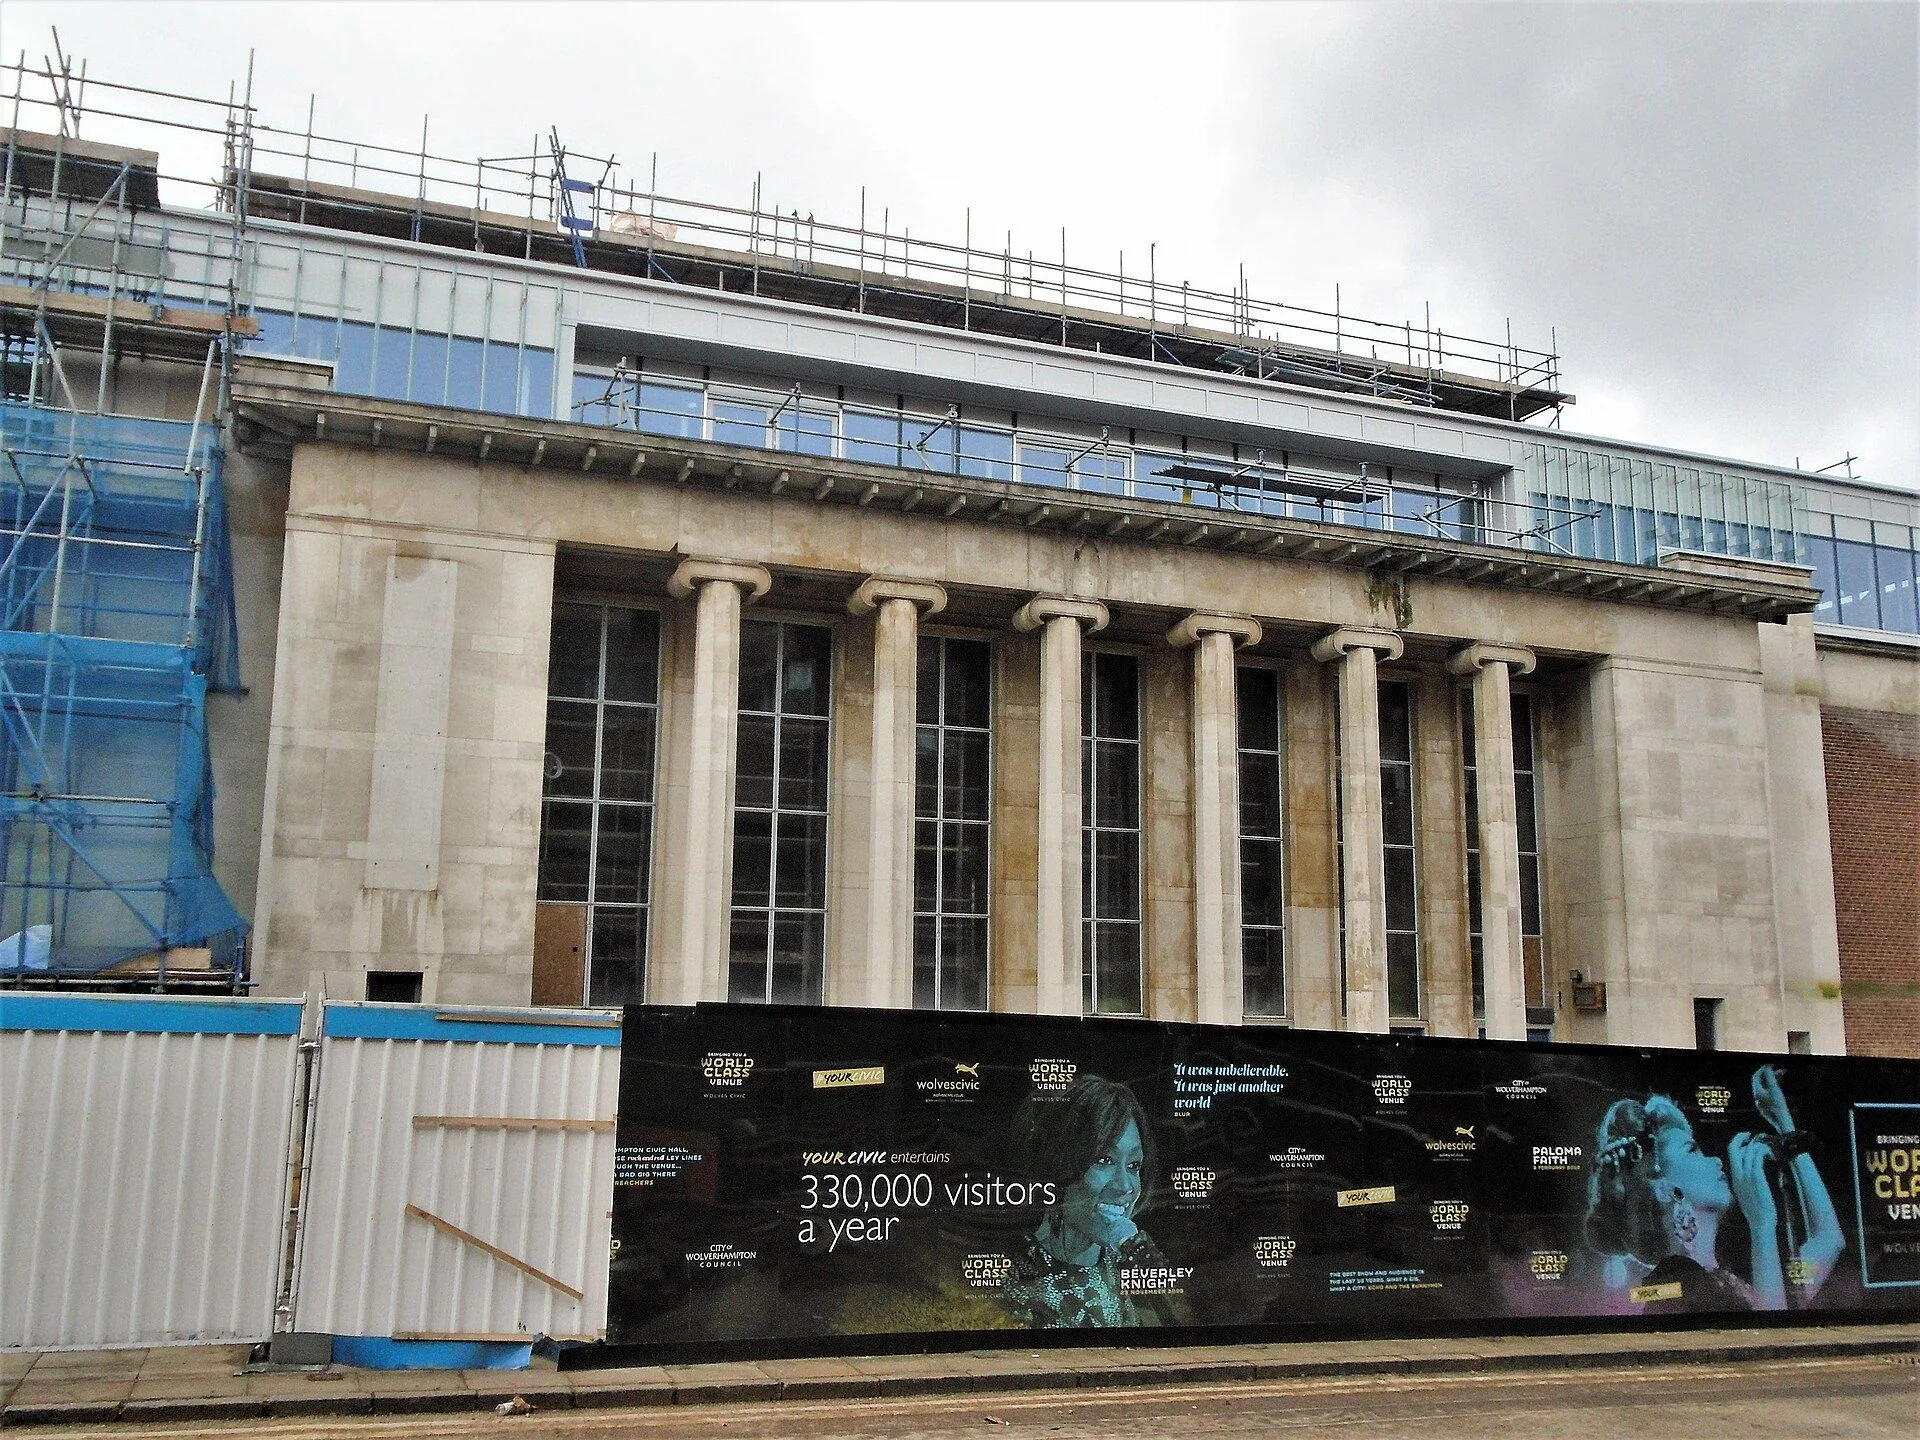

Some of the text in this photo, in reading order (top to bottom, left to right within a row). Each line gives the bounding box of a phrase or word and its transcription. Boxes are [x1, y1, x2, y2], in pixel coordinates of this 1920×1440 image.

[701, 1058, 754, 1068] WORLD
[1029, 1063, 1077, 1073] WORLD
[704, 1068, 750, 1077] CLASS
[1187, 1066, 1213, 1076] was
[1215, 1063, 1289, 1077] unbelievable.
[1032, 1073, 1074, 1082] CLASS
[916, 1077, 981, 1090] wolvescivic
[1187, 1083, 1213, 1092] was
[1212, 1079, 1236, 1096] just
[1238, 1080, 1284, 1093] another
[1371, 1079, 1412, 1088] WORLD
[1512, 1079, 1525, 1087] CITY
[1374, 1088, 1409, 1097] CLASS
[1696, 1090, 1731, 1099] WORLD
[1174, 1096, 1211, 1109] world
[1698, 1098, 1729, 1107] CLASS
[1877, 1135, 1920, 1144] BRINGING
[1425, 1139, 1477, 1151] wolvescivic
[1532, 1146, 1582, 1156] PALOMA
[890, 1150, 950, 1164] entertains
[1269, 1154, 1325, 1162] WOLVERHAMPTON
[1532, 1156, 1568, 1165] FAITH
[1171, 1171, 1216, 1181] WORLD
[1174, 1181, 1213, 1190] CLASS
[800, 1172, 1057, 1212] 330,000 visitors
[1430, 1204, 1470, 1214] WORLD
[1432, 1213, 1467, 1222] CLASS
[798, 1216, 900, 1253] a year
[710, 1244, 726, 1252] CITY
[1252, 1240, 1296, 1250] WORLD
[685, 1251, 757, 1261] WOLVERHAMPTON
[1256, 1250, 1294, 1259] CLASS
[1531, 1254, 1568, 1264] WORLD
[961, 1258, 1012, 1269] WORLD
[1531, 1264, 1566, 1272] CLASS
[964, 1268, 1009, 1279] CLASS
[1120, 1267, 1194, 1279] BEVERLEY
[970, 1279, 1002, 1287] VENUE
[1120, 1278, 1177, 1290] KNIGHT
